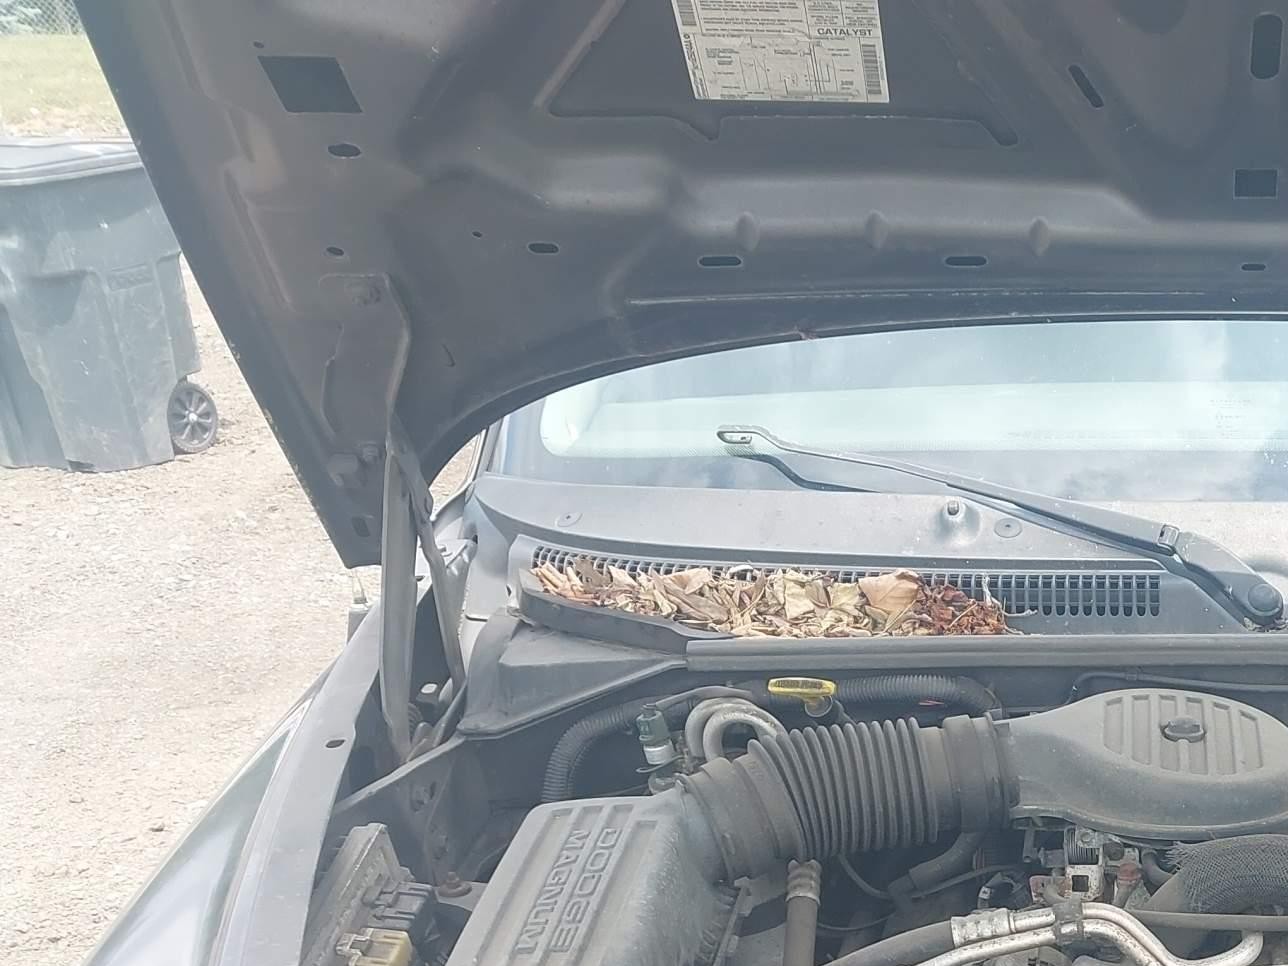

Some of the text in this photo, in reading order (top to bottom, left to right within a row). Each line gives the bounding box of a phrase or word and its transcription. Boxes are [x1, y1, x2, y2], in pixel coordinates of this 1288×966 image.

[816, 27, 873, 36] CATALYST
[514, 828, 591, 955] MAGNUM
[550, 827, 623, 953] DODGE
